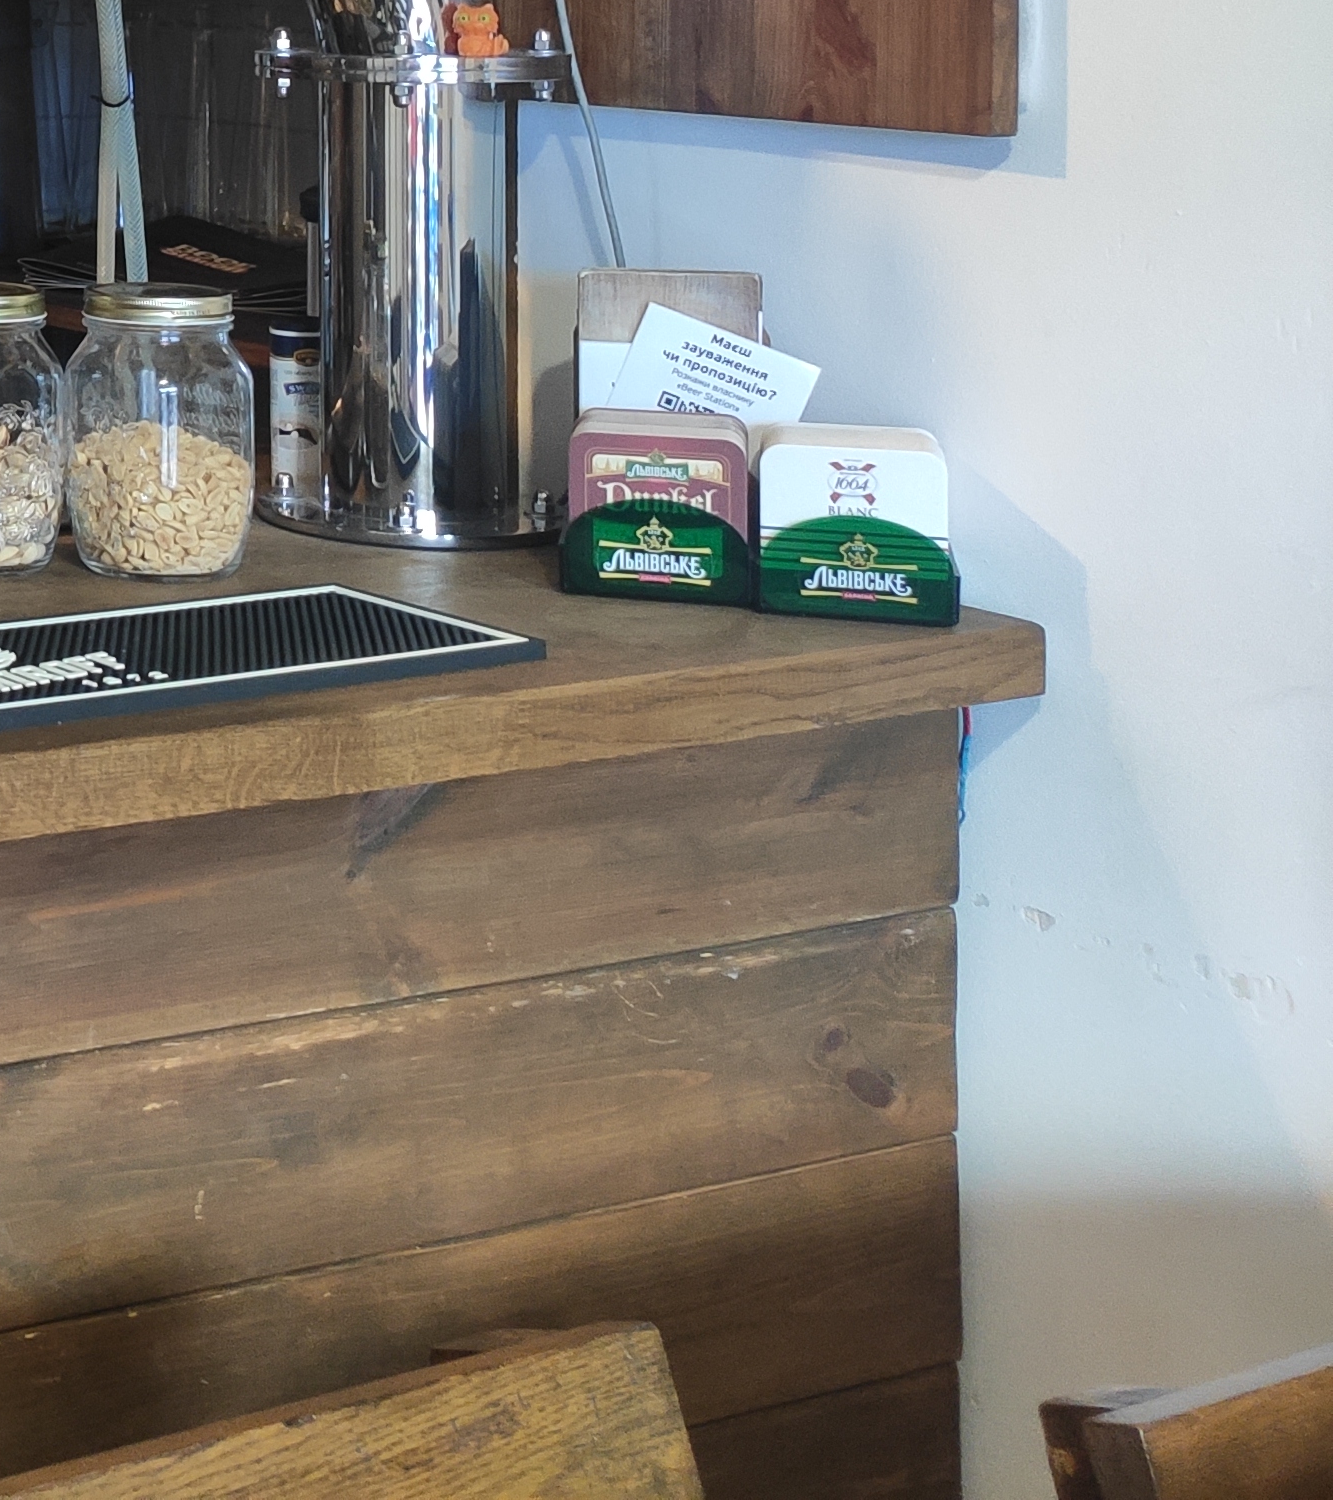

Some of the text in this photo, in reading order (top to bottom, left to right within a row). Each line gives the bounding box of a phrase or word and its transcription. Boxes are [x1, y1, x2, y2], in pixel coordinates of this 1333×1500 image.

[710, 333, 752, 358] Маєш
[681, 340, 769, 381] зауваження
[663, 349, 777, 401] чи пропозицію?
[626, 463, 687, 481] ЛЬВІВСЬКЕ
[834, 476, 870, 492] 1664
[828, 504, 880, 519] BLANC
[603, 548, 707, 579] ЛЬВІВСЬКЕ
[804, 565, 913, 597] ЛЬВІВСЬКЕ
